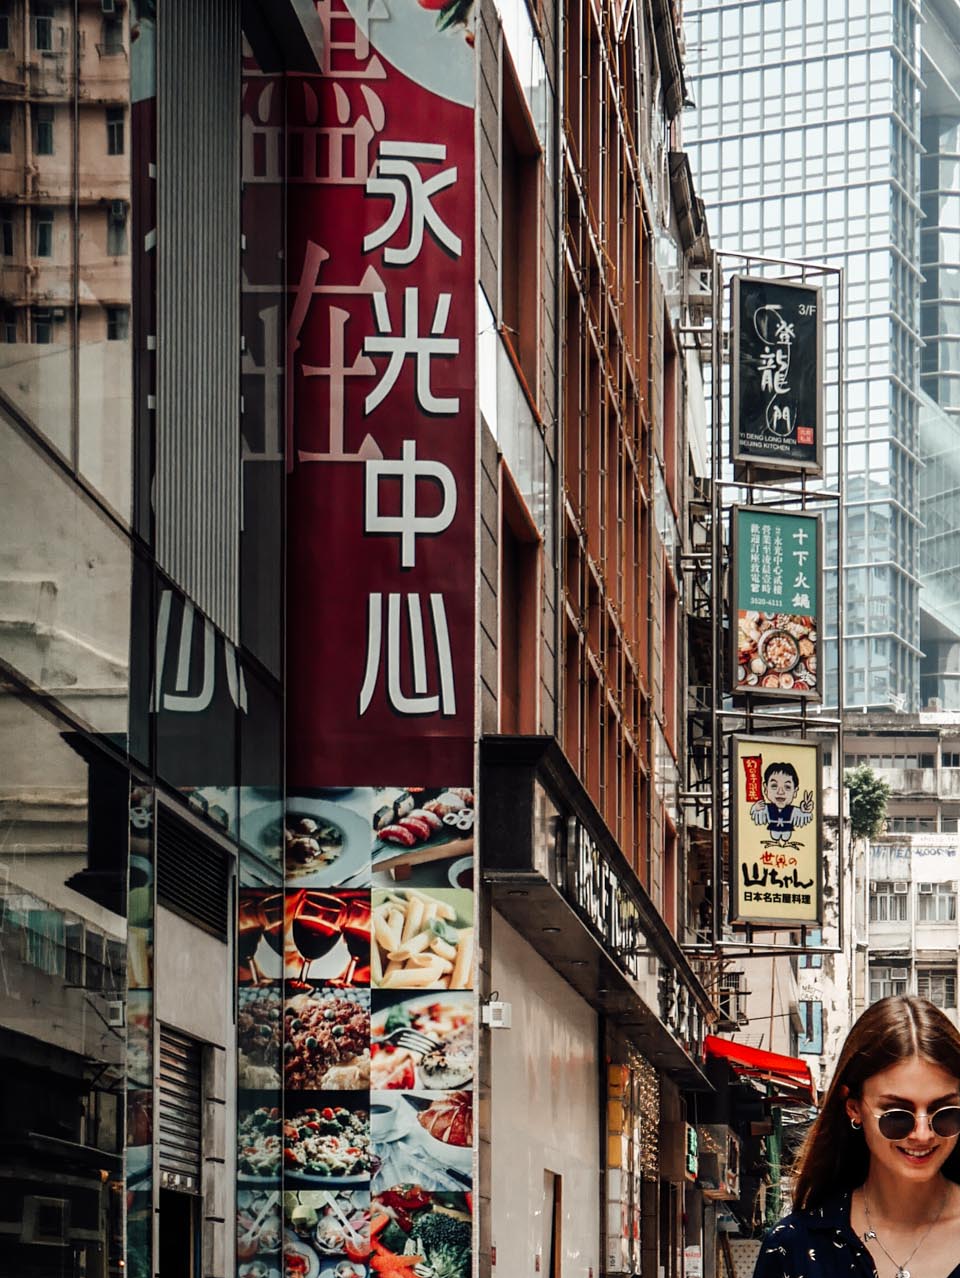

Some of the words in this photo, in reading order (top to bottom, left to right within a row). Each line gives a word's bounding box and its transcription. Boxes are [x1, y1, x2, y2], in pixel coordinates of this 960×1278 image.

[798, 304, 817, 316] 3/F
[359, 140, 462, 716] 永光中心
[746, 433, 764, 441] DENG
[765, 435, 782, 443] LONG
[764, 443, 791, 451] KITCHEN
[760, 851, 798, 868] 世界の
[742, 862, 814, 889] 山ちゃん
[744, 891, 811, 904] 日本名古屋料理
